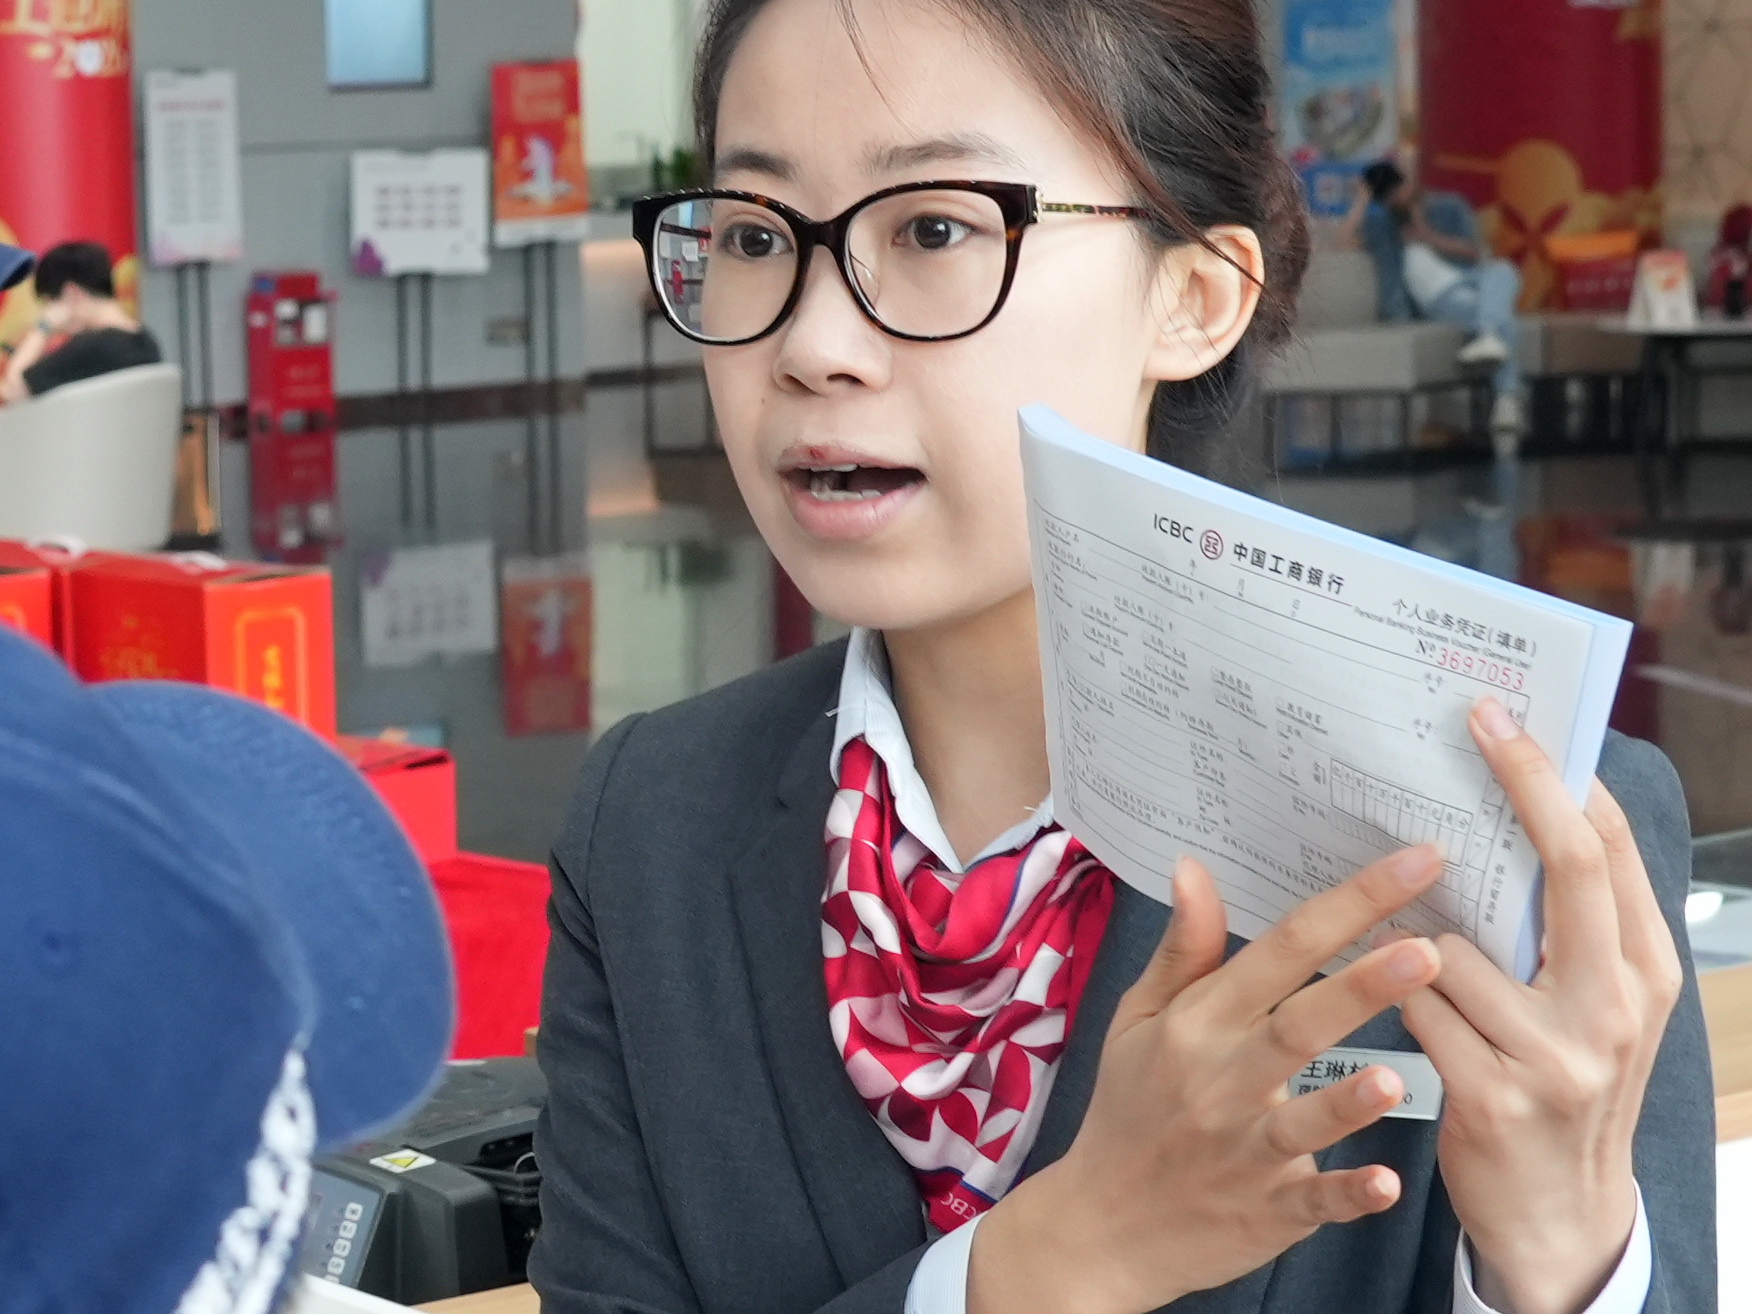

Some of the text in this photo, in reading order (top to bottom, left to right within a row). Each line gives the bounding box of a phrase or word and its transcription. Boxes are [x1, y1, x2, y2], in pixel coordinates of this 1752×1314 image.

[1153, 513, 1194, 543] ICBC
[1233, 541, 1345, 595] 中国工商银行
[1436, 647, 1525, 691] 3697053
